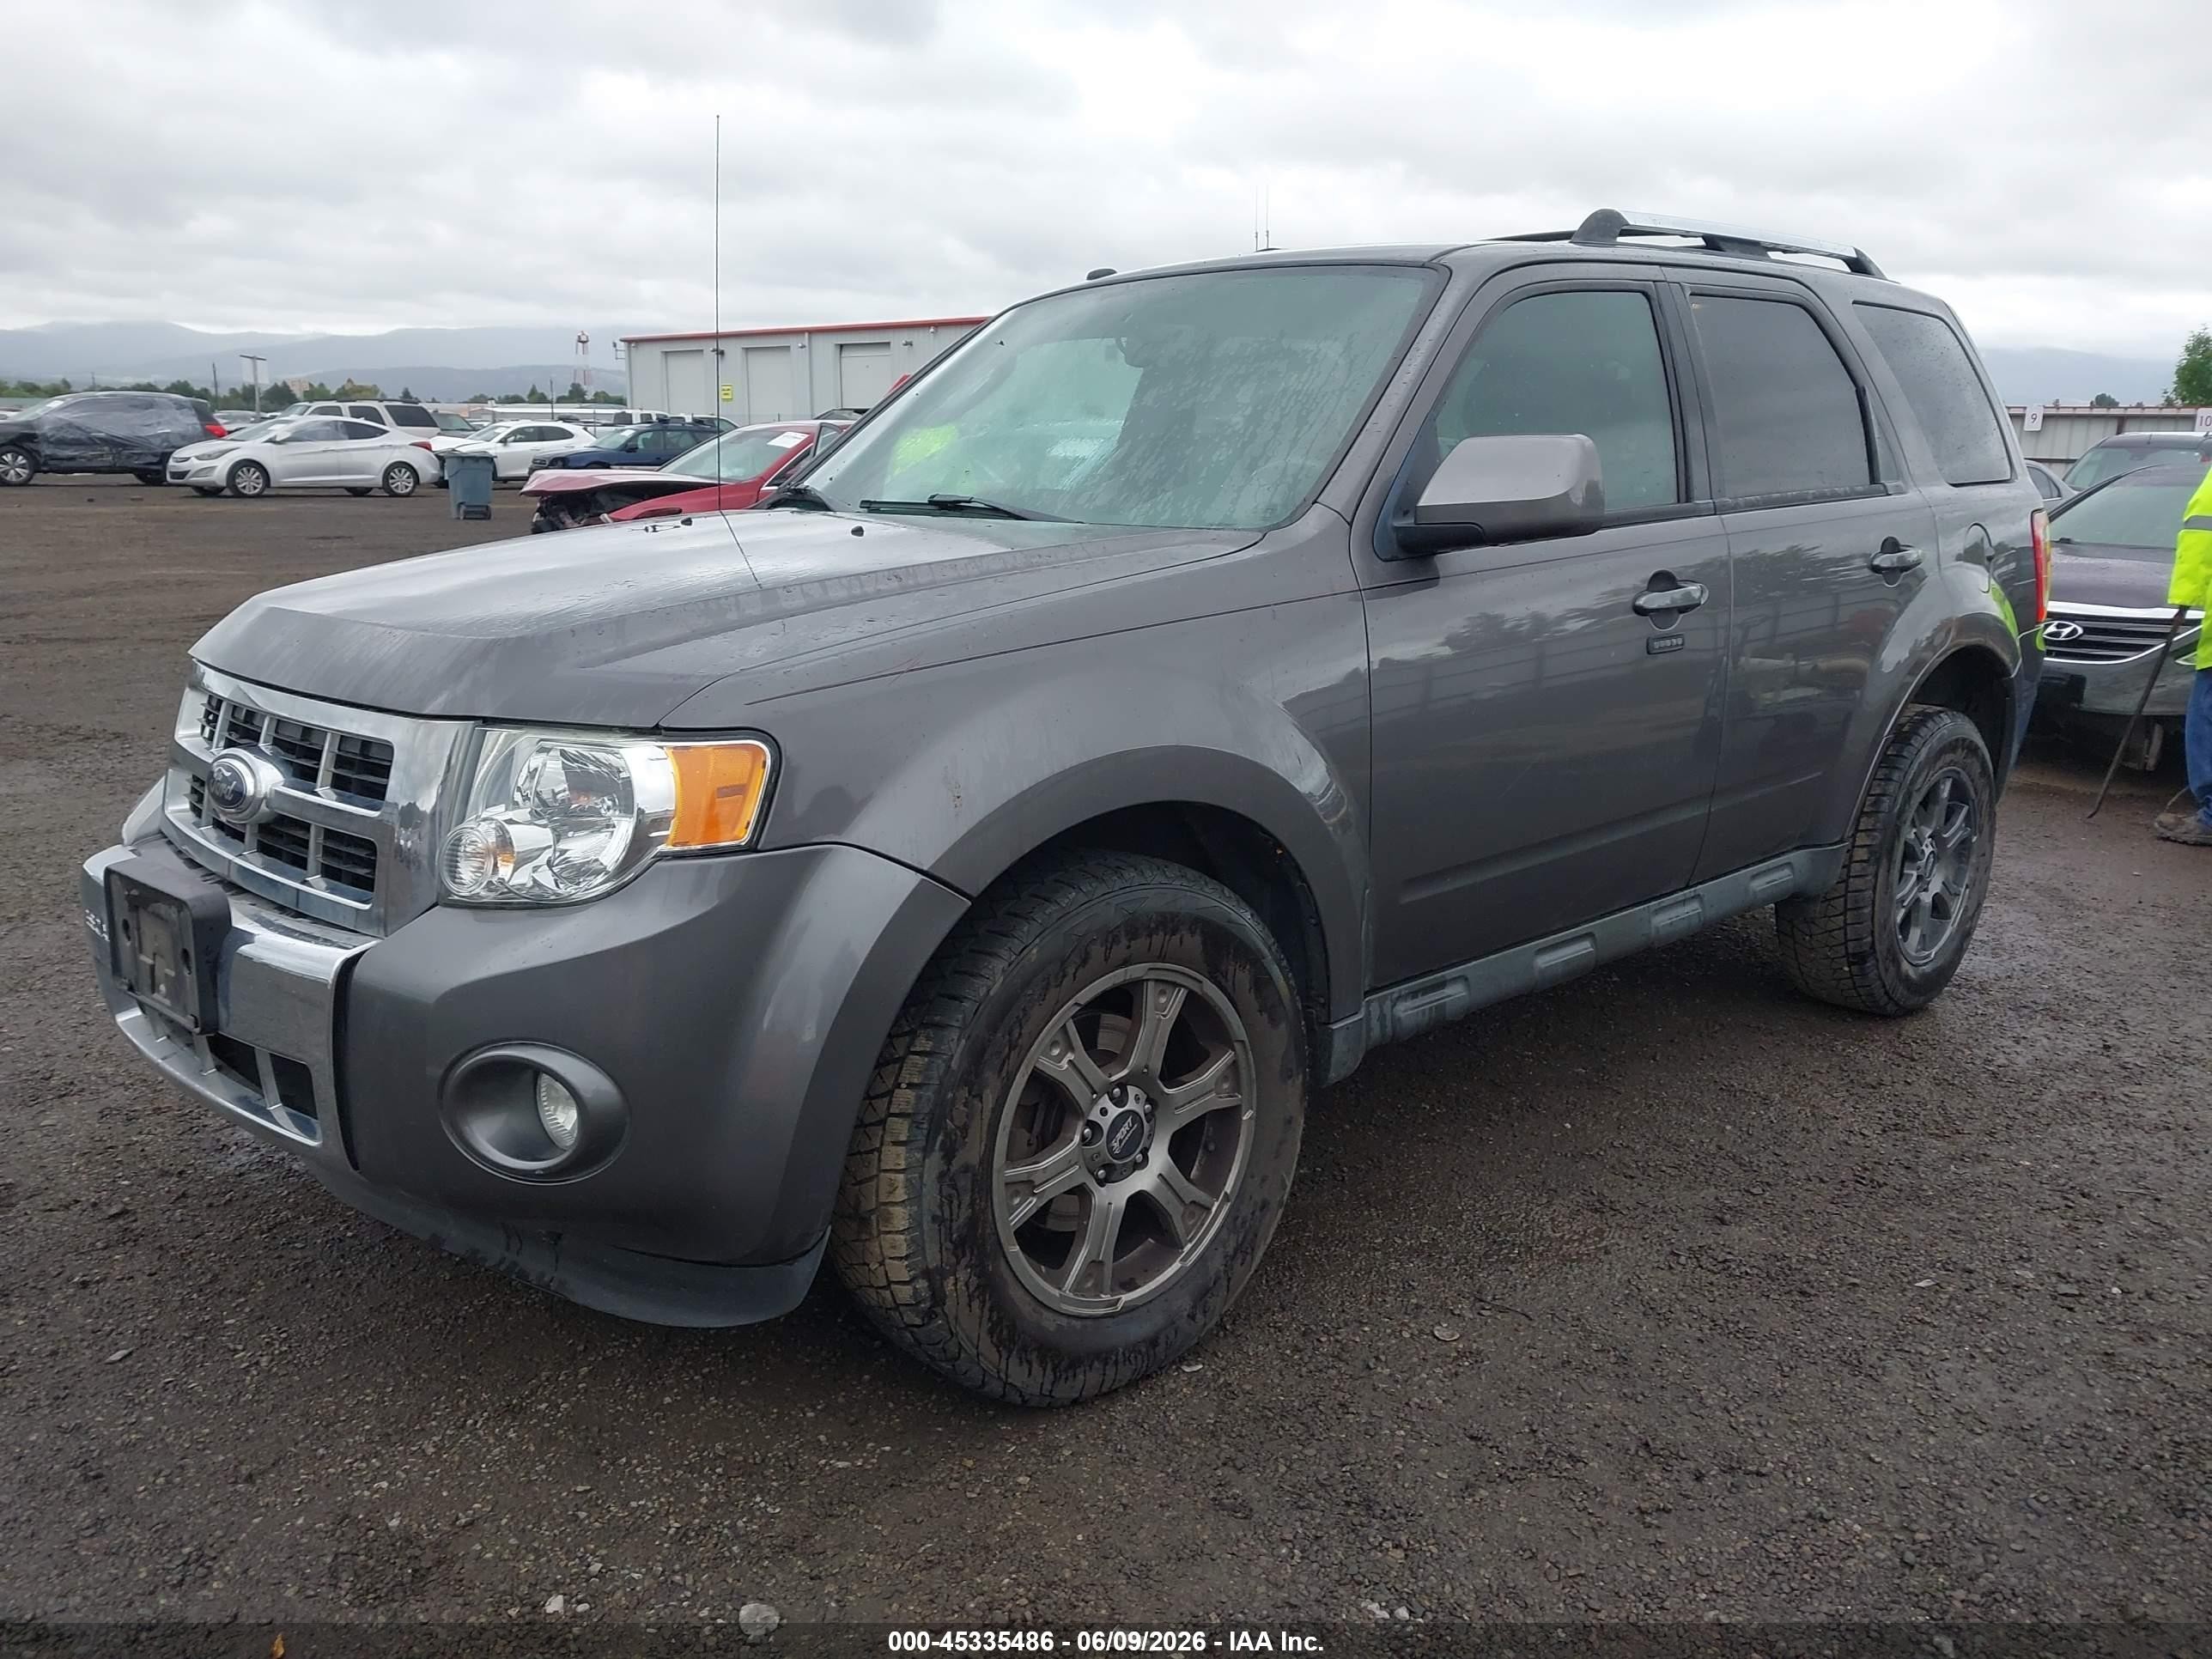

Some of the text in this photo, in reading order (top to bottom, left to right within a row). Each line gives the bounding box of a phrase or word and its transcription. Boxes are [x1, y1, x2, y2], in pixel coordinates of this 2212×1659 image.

[2031, 413, 2038, 423] 9
[2199, 415, 2212, 427] 10
[210, 766, 237, 801] Ford
